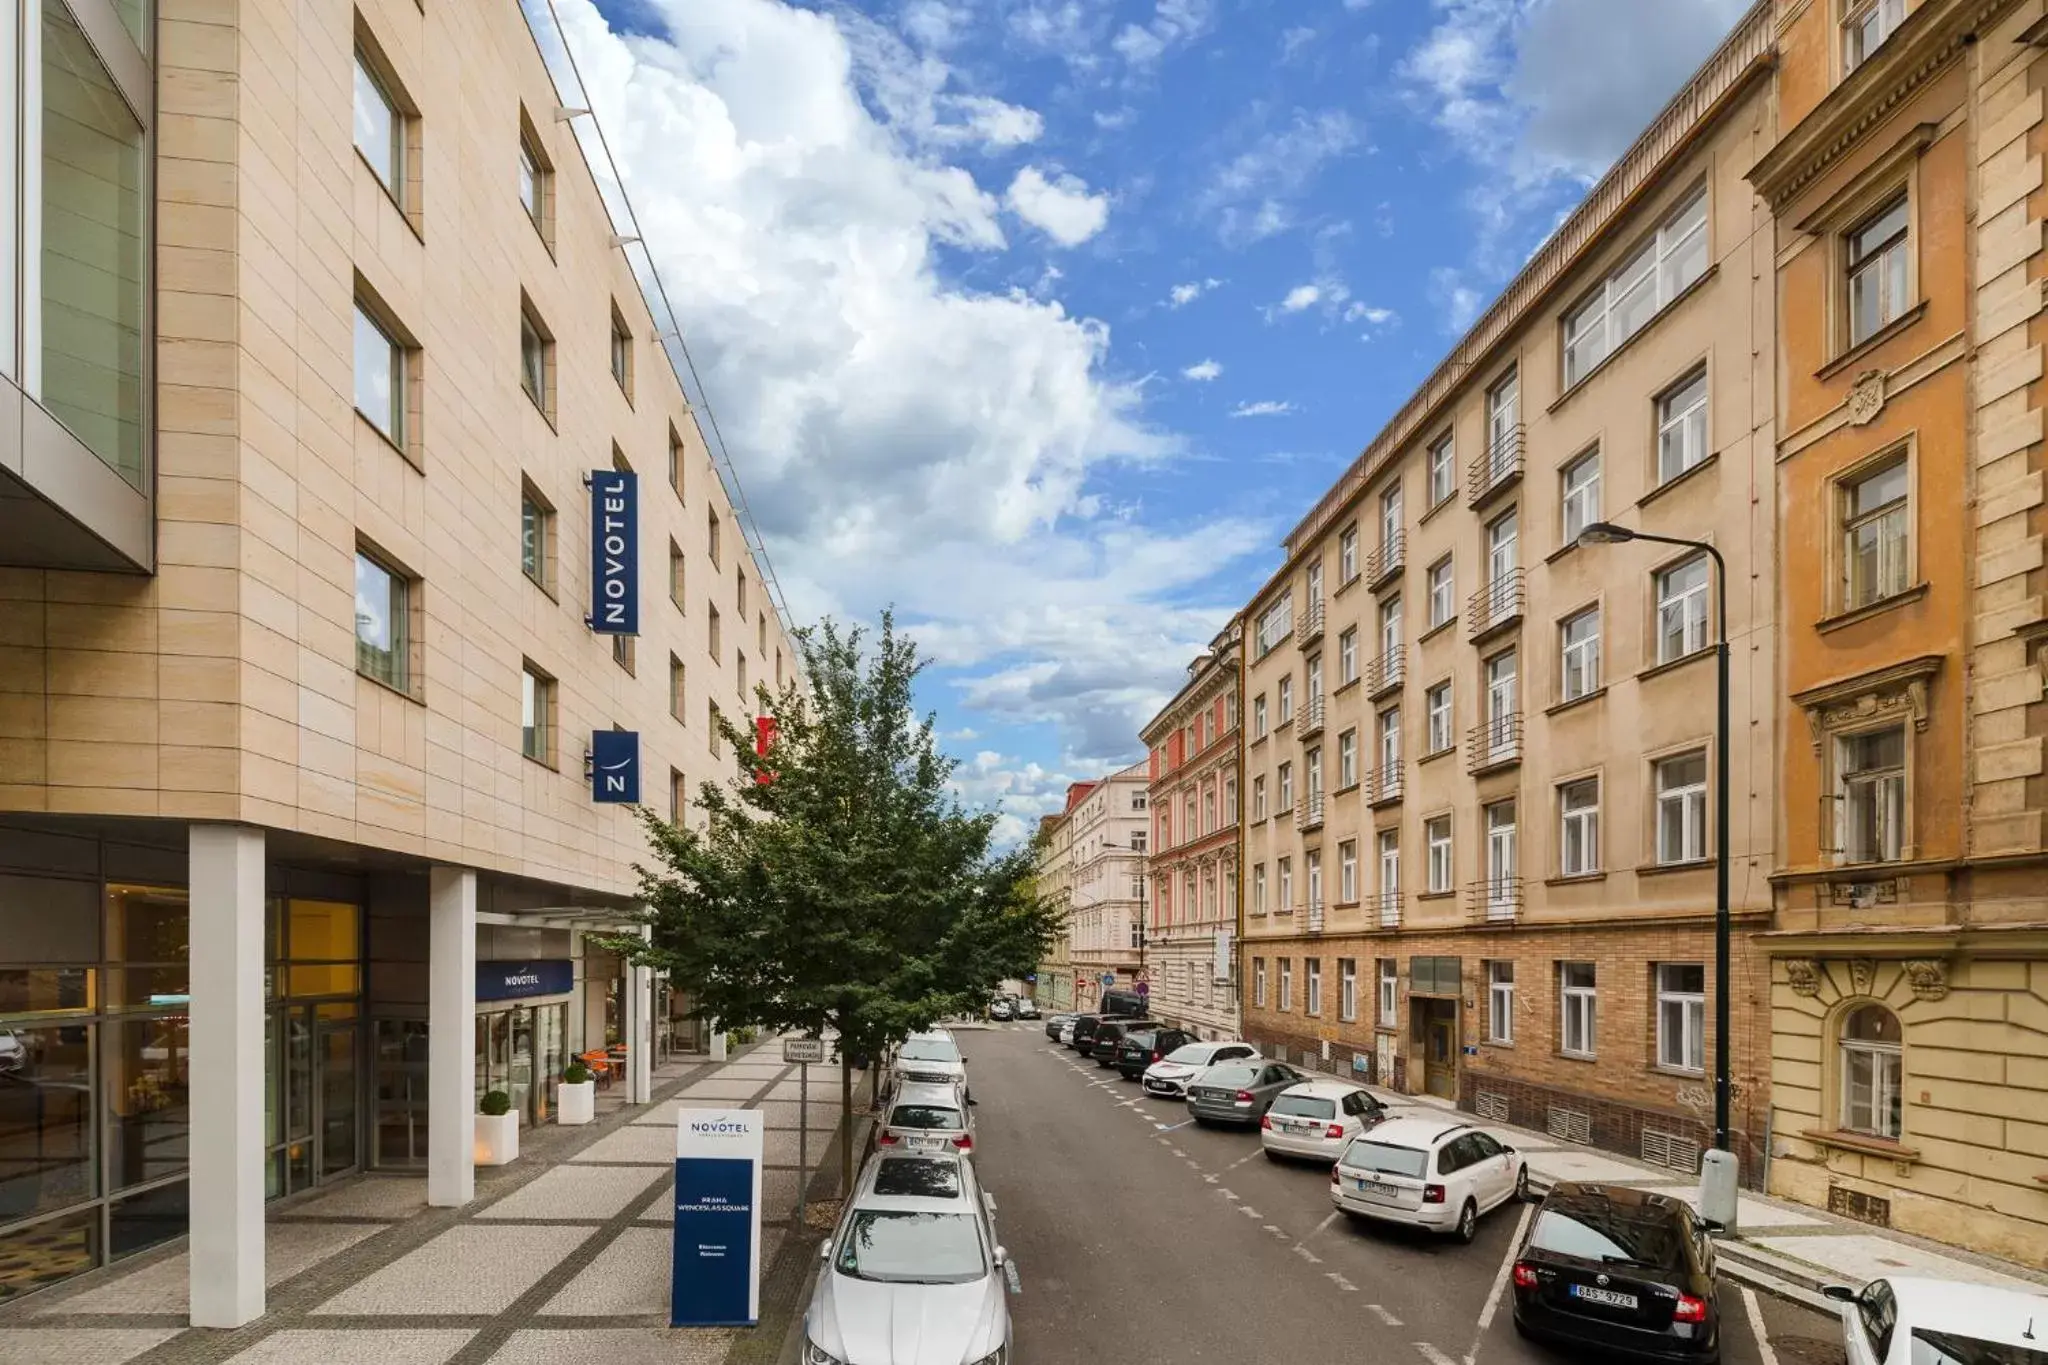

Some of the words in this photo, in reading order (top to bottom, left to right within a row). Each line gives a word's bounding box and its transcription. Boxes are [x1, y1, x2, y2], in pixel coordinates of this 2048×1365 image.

[605, 479, 625, 623] NOVOTEL
[607, 775, 624, 792] N
[505, 975, 539, 986] NOVOTEL
[691, 1123, 749, 1133] NOVOTEL
[1579, 1286, 1599, 1299] 6AS
